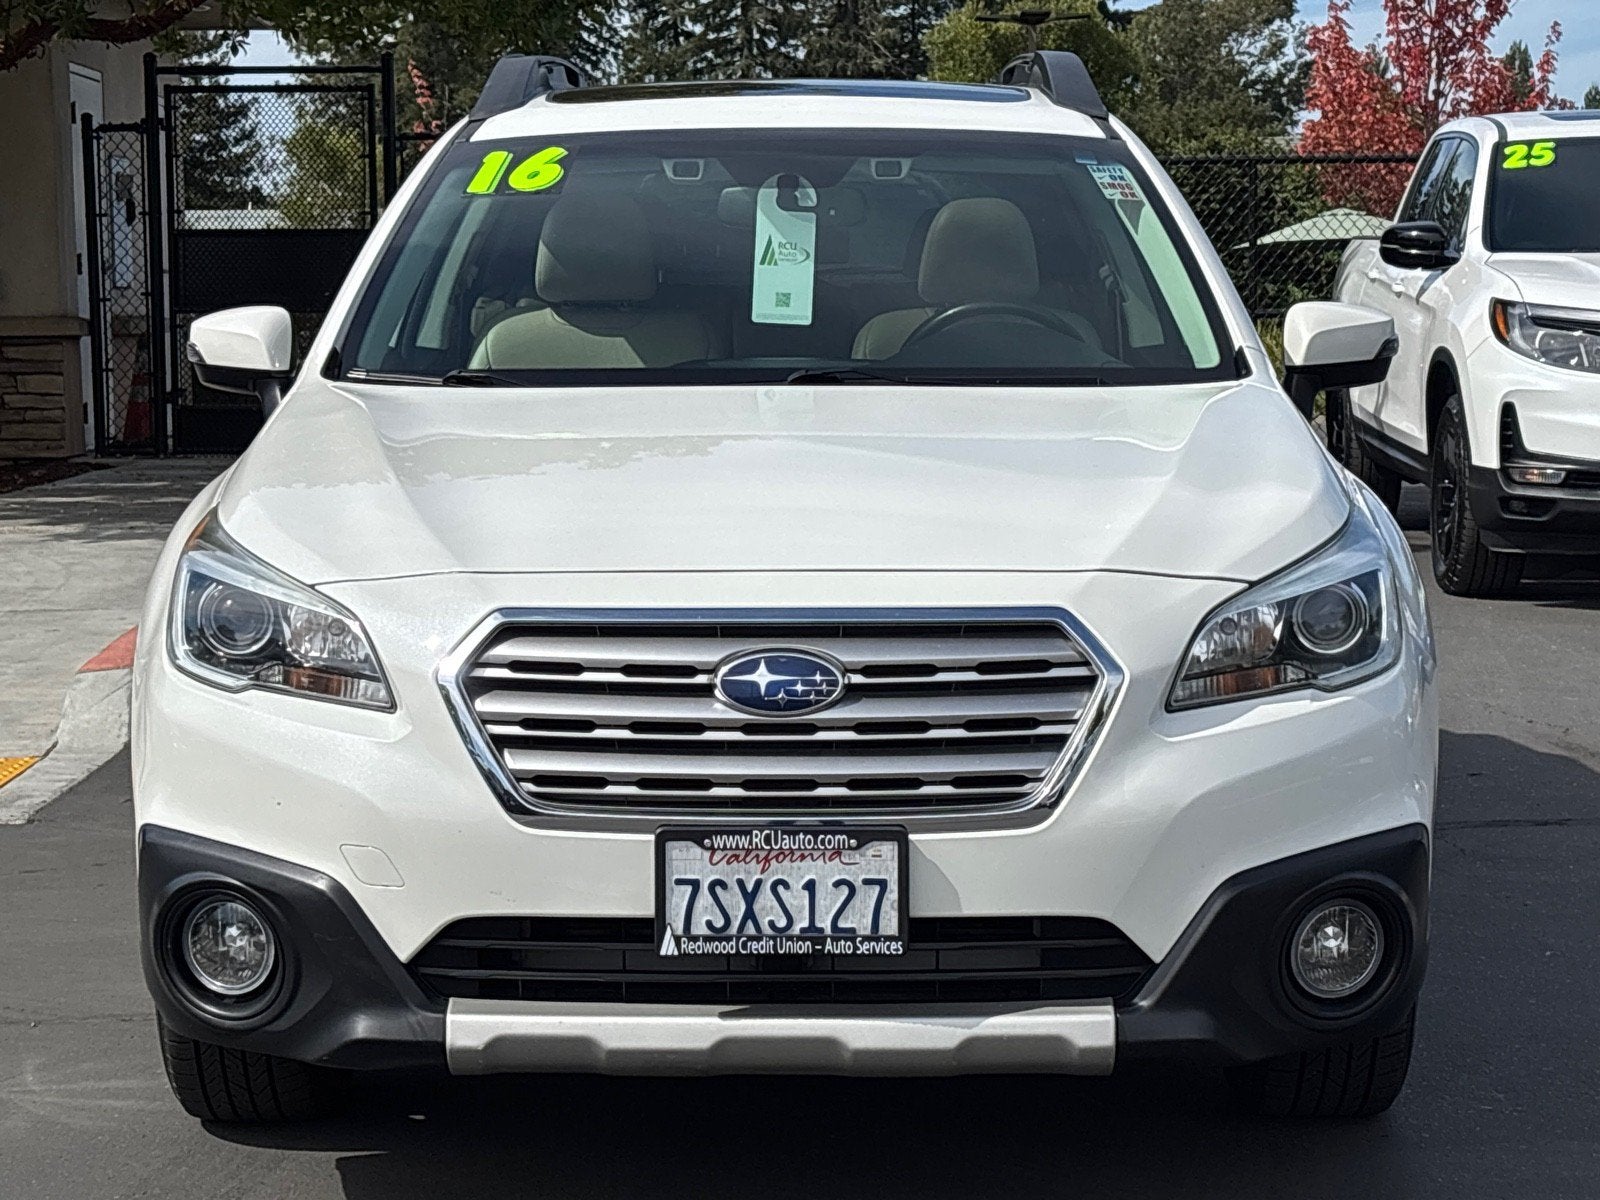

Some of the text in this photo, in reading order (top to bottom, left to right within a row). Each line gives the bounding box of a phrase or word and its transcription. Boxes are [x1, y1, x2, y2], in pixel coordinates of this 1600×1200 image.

[1503, 141, 1556, 169] 25
[466, 146, 569, 194] 16
[1089, 166, 1125, 174] SAFETY
[1099, 182, 1134, 191] SMOG
[1120, 191, 1139, 199] OK
[778, 241, 797, 250] RCU
[778, 250, 797, 258] Auto
[712, 830, 849, 850] www.RCUauto.com
[709, 849, 859, 875] California
[673, 878, 889, 935] 7SXS127
[681, 937, 736, 954] Redwood
[739, 937, 775, 954] Credit
[779, 937, 812, 954] Union
[825, 937, 853, 954] Auto
[856, 937, 903, 955] Services
